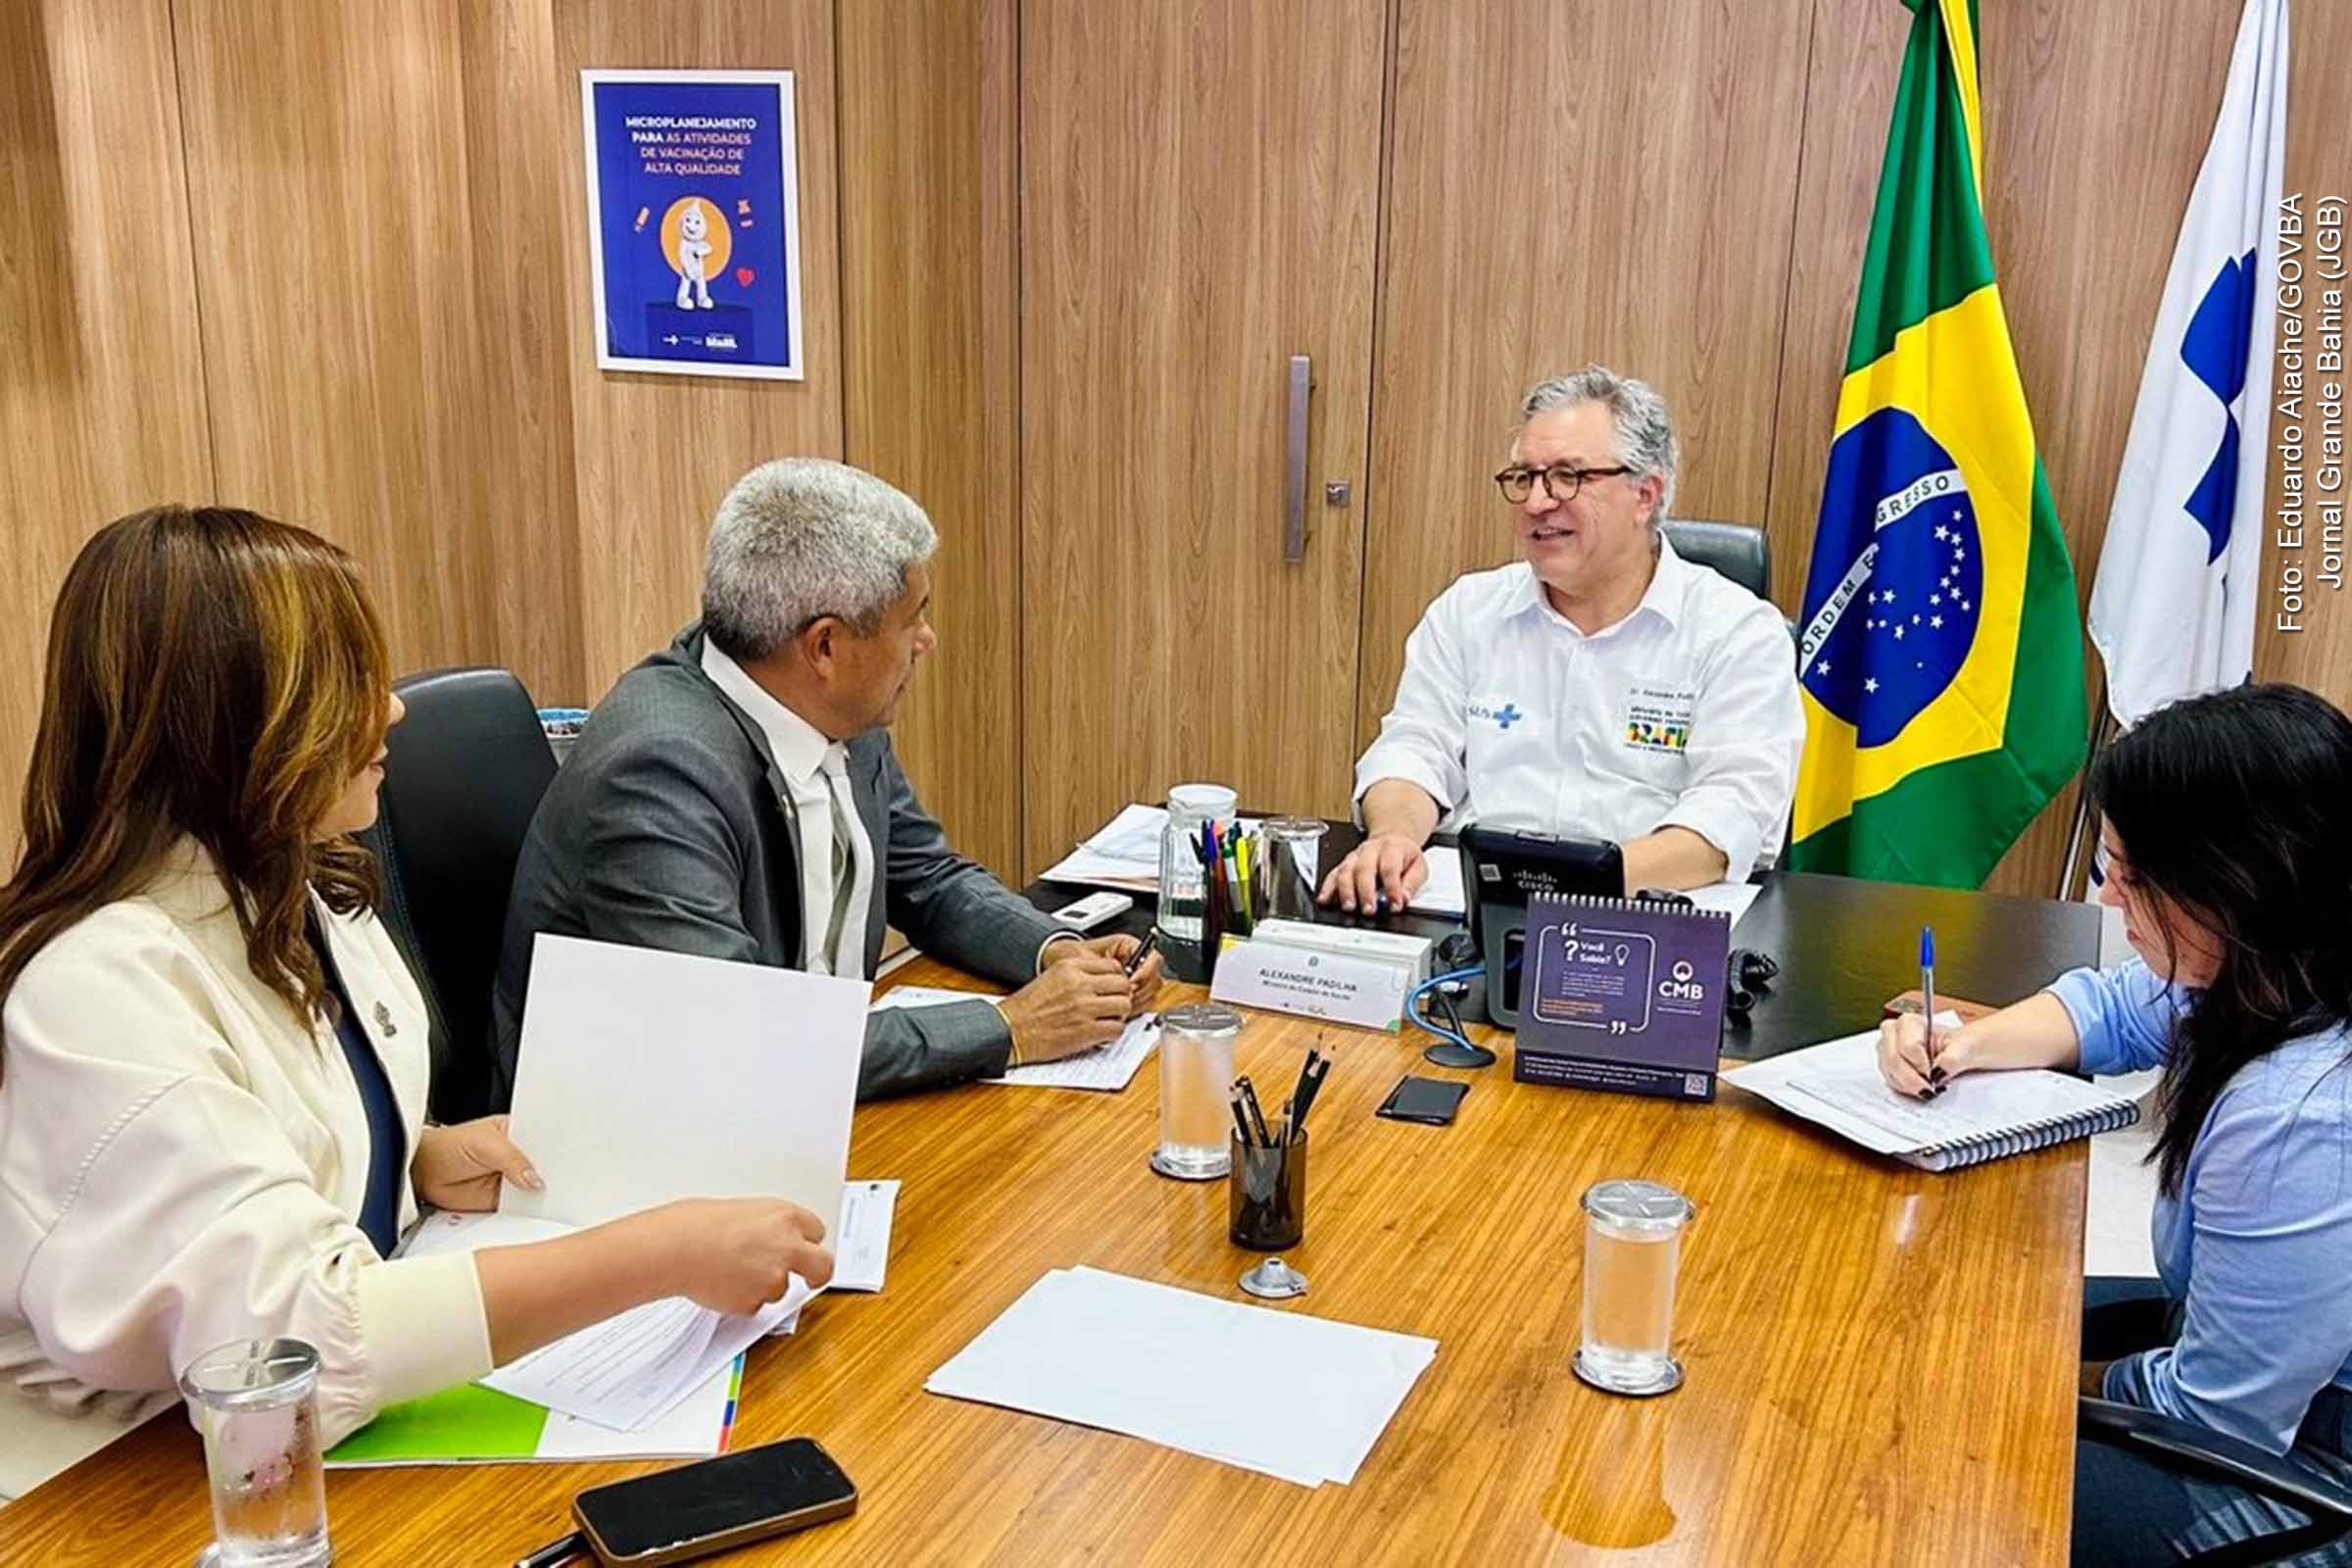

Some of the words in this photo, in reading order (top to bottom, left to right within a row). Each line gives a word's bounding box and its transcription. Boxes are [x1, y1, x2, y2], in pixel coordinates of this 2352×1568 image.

[625, 117, 757, 129] MICROPLANEJAMENTO
[632, 131, 664, 143] PARA
[665, 132, 681, 143] AS
[683, 132, 752, 145] ATIVIDADES
[640, 146, 659, 158] DE
[659, 146, 725, 160] VACINAÇÃO
[726, 148, 744, 161] DE
[644, 162, 674, 173] ALTA
[675, 163, 742, 175] QUALIDADE
[1801, 578, 1857, 655] ORDEM
[1876, 474, 1949, 523] GRESSO
[1259, 968, 1315, 985] ALEXANDRE
[1658, 981, 1704, 1000] CMB
